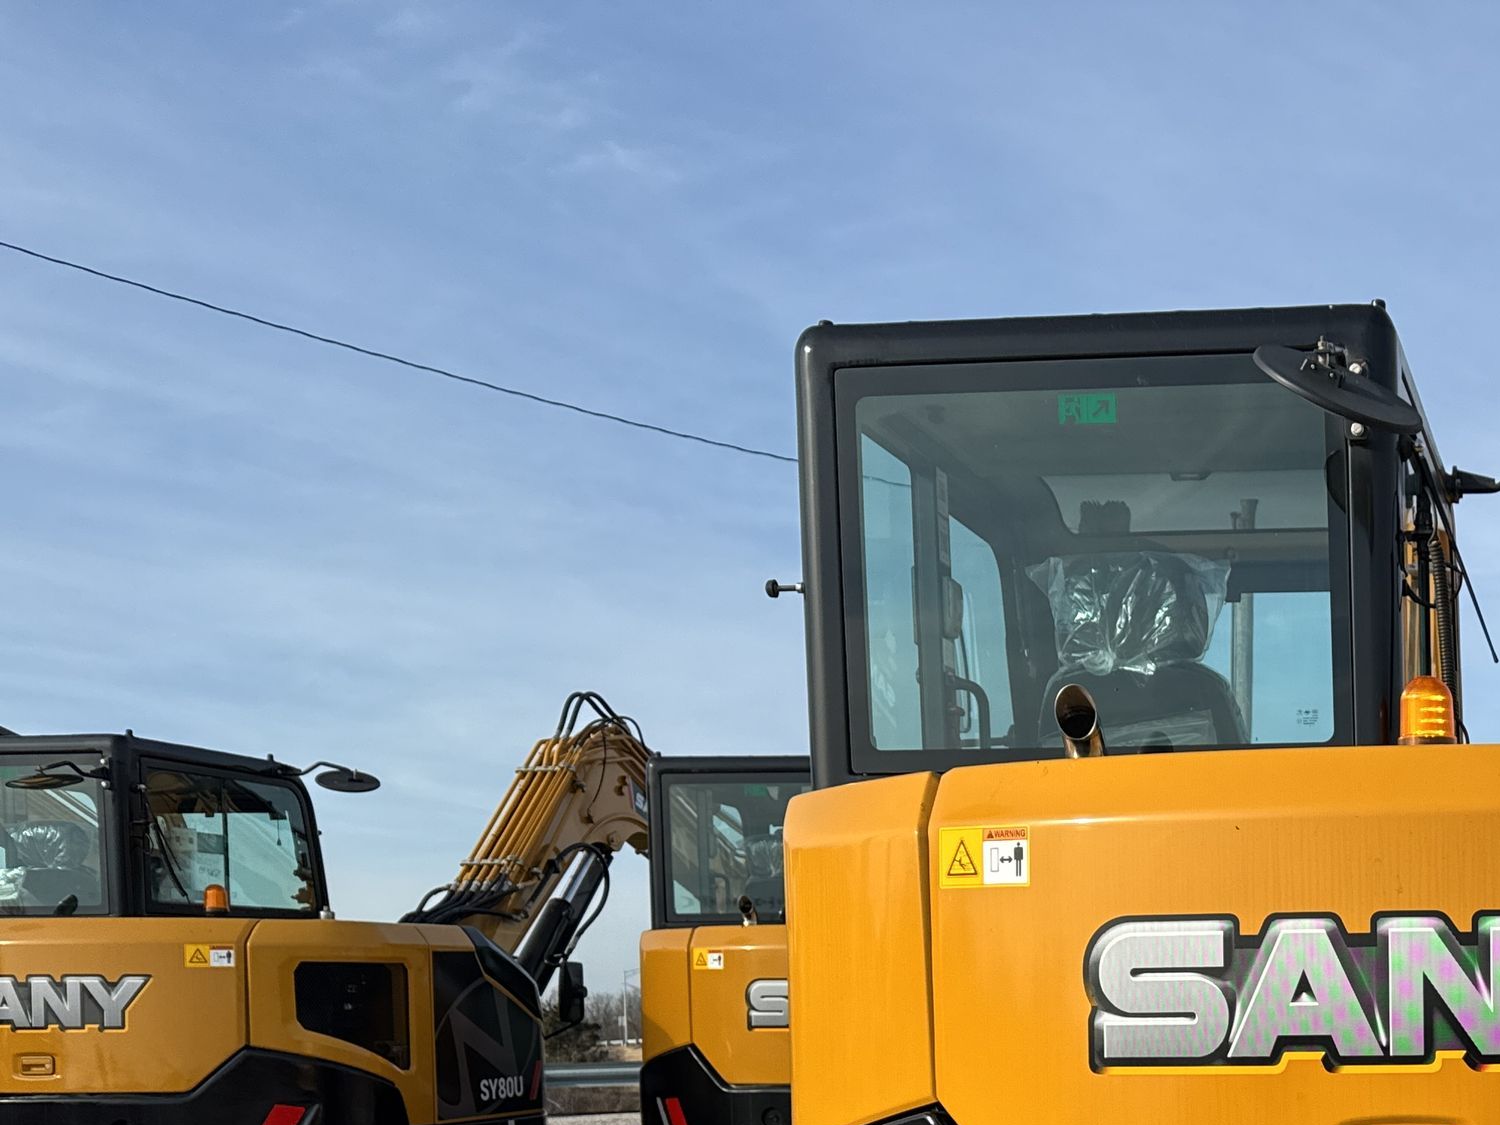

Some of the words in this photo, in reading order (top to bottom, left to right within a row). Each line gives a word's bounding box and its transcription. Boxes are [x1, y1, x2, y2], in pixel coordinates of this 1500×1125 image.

[994, 829, 1026, 838] WARNING
[0, 974, 151, 1032] ANY
[480, 1075, 524, 1101] SY80U
